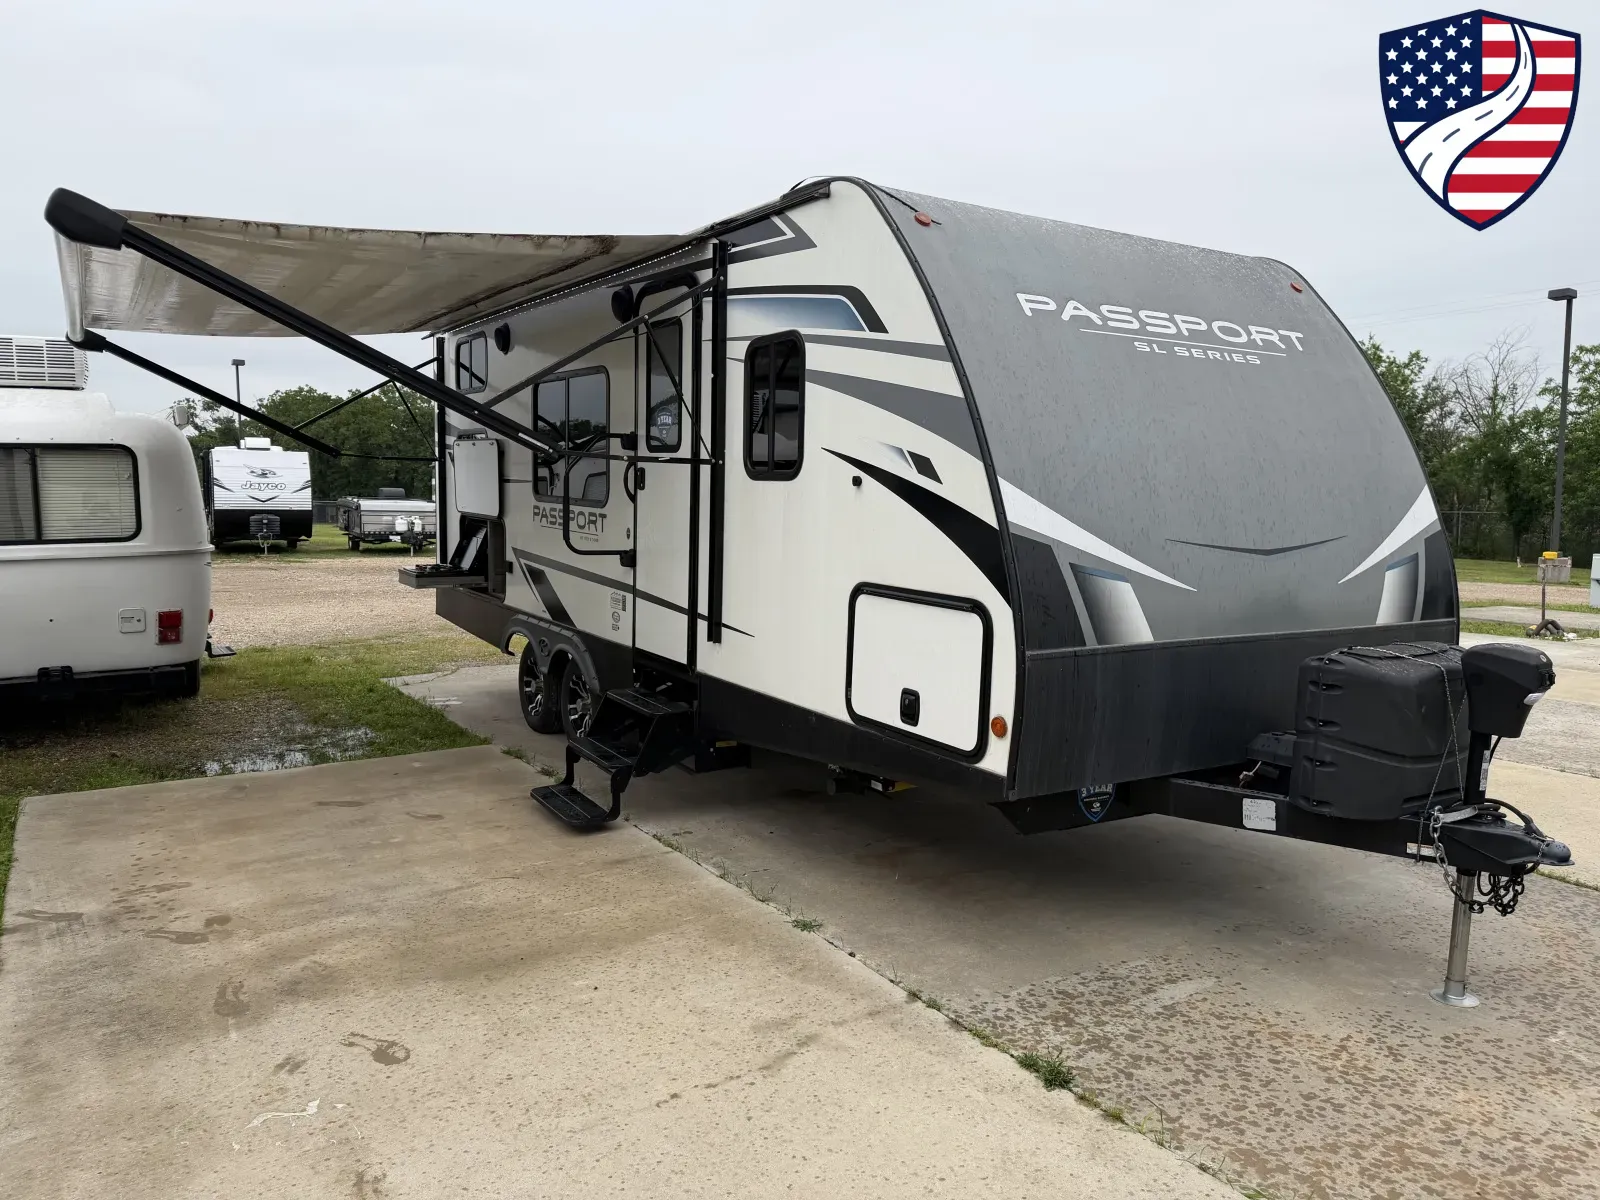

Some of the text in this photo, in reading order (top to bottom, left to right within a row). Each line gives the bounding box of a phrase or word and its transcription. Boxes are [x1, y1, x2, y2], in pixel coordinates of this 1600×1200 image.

[1016, 292, 1304, 351] PASSPORT
[1133, 341, 1261, 365] SL SERIES
[241, 480, 286, 492] Jayco
[532, 504, 607, 533] PASSPORT
